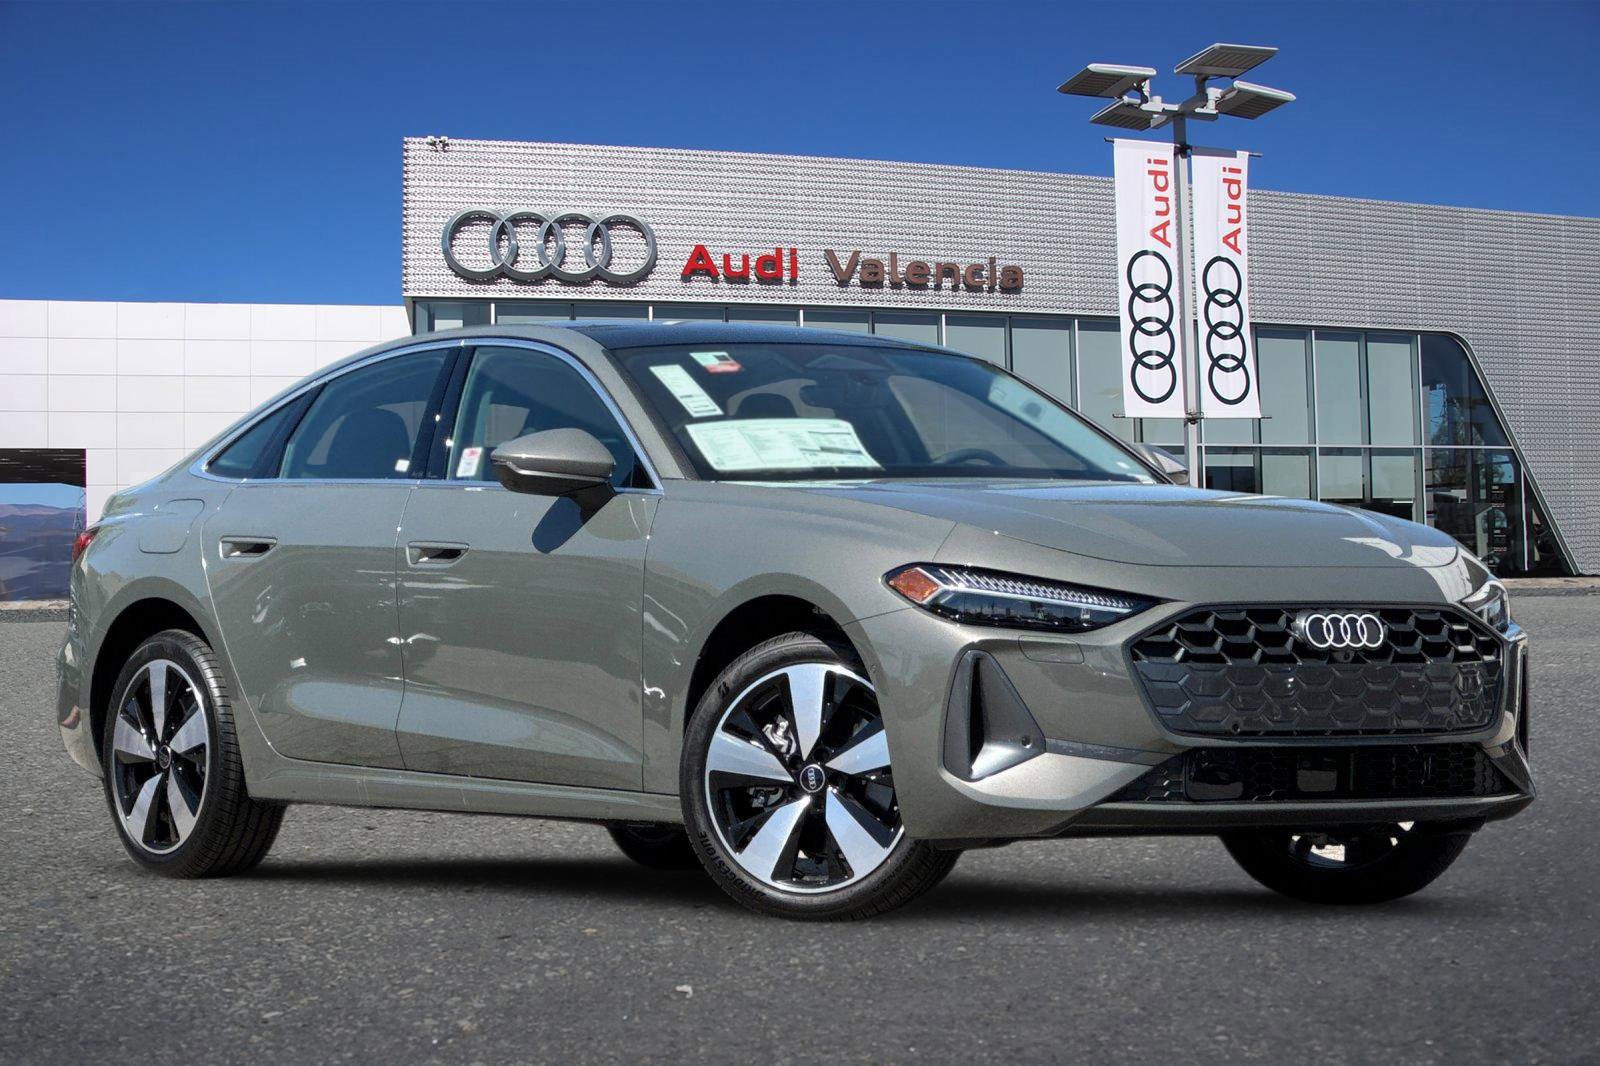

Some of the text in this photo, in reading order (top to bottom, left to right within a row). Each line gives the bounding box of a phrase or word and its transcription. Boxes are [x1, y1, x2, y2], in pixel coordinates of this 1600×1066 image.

[1147, 158, 1171, 248] Audi
[1222, 167, 1242, 255] Audi
[681, 244, 1024, 291] Audi Valencia
